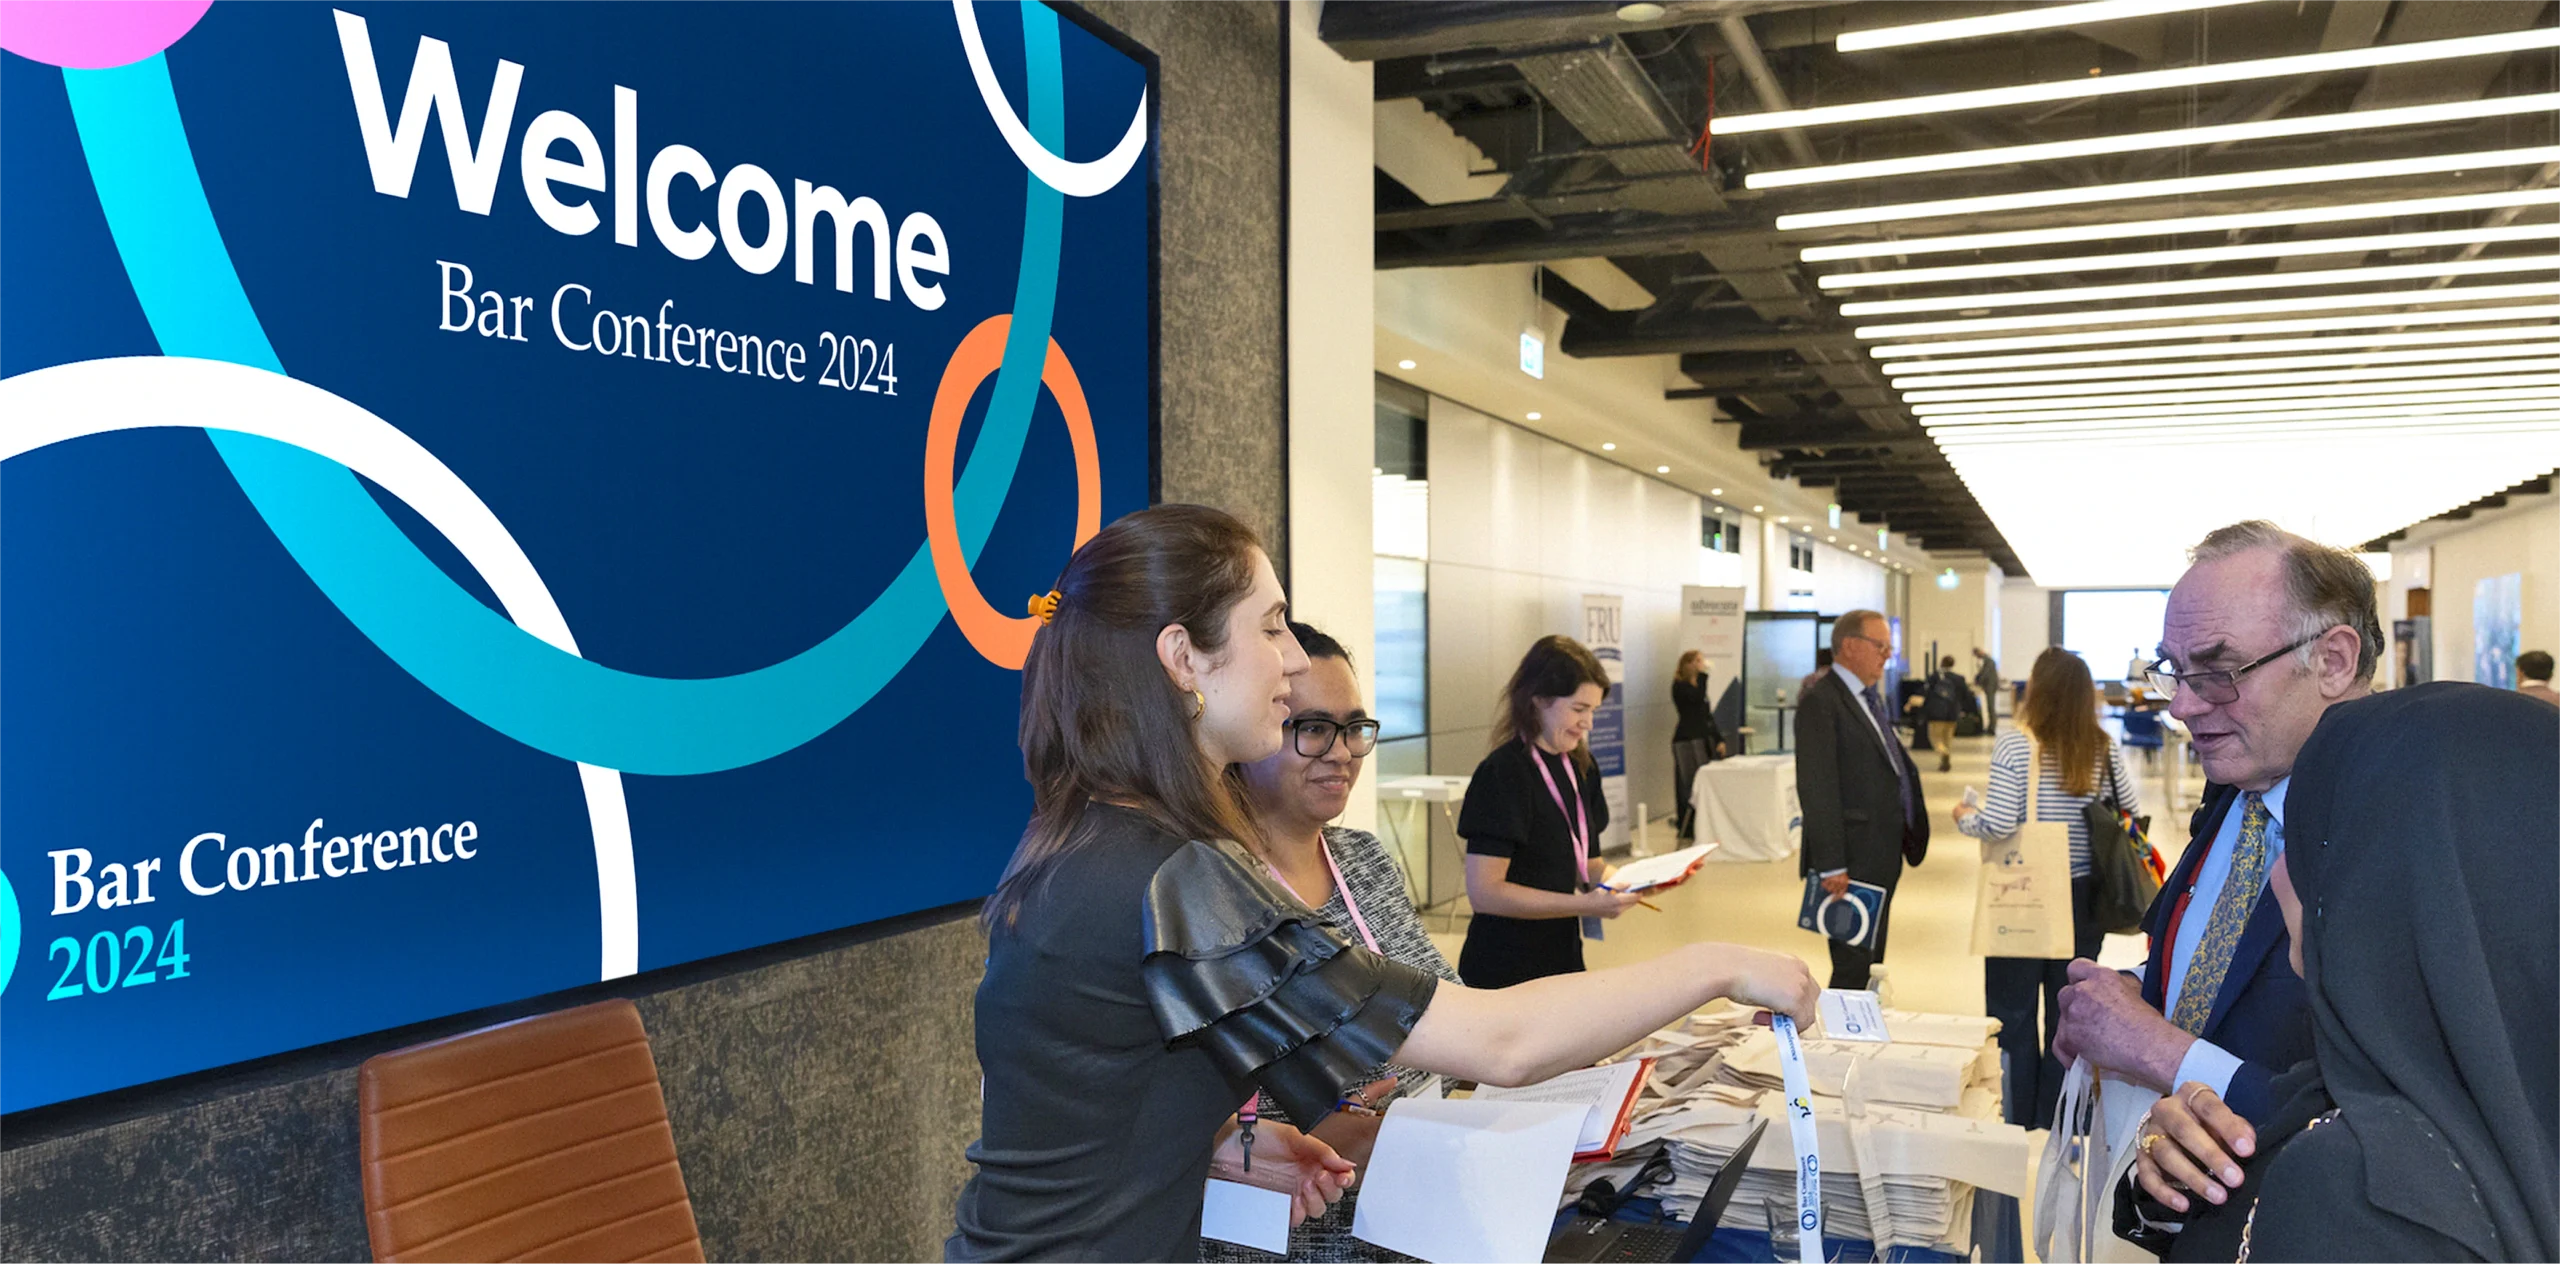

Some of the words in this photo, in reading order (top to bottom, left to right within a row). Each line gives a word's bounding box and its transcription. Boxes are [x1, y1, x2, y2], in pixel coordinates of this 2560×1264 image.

[333, 9, 950, 311] Welcome
[436, 260, 534, 342] Bar
[552, 284, 806, 383] Conference
[818, 332, 898, 396] 2024
[1587, 606, 1621, 644] FRU
[48, 848, 160, 915] Bar
[179, 819, 478, 896] Conference
[47, 919, 191, 1001] 2024
